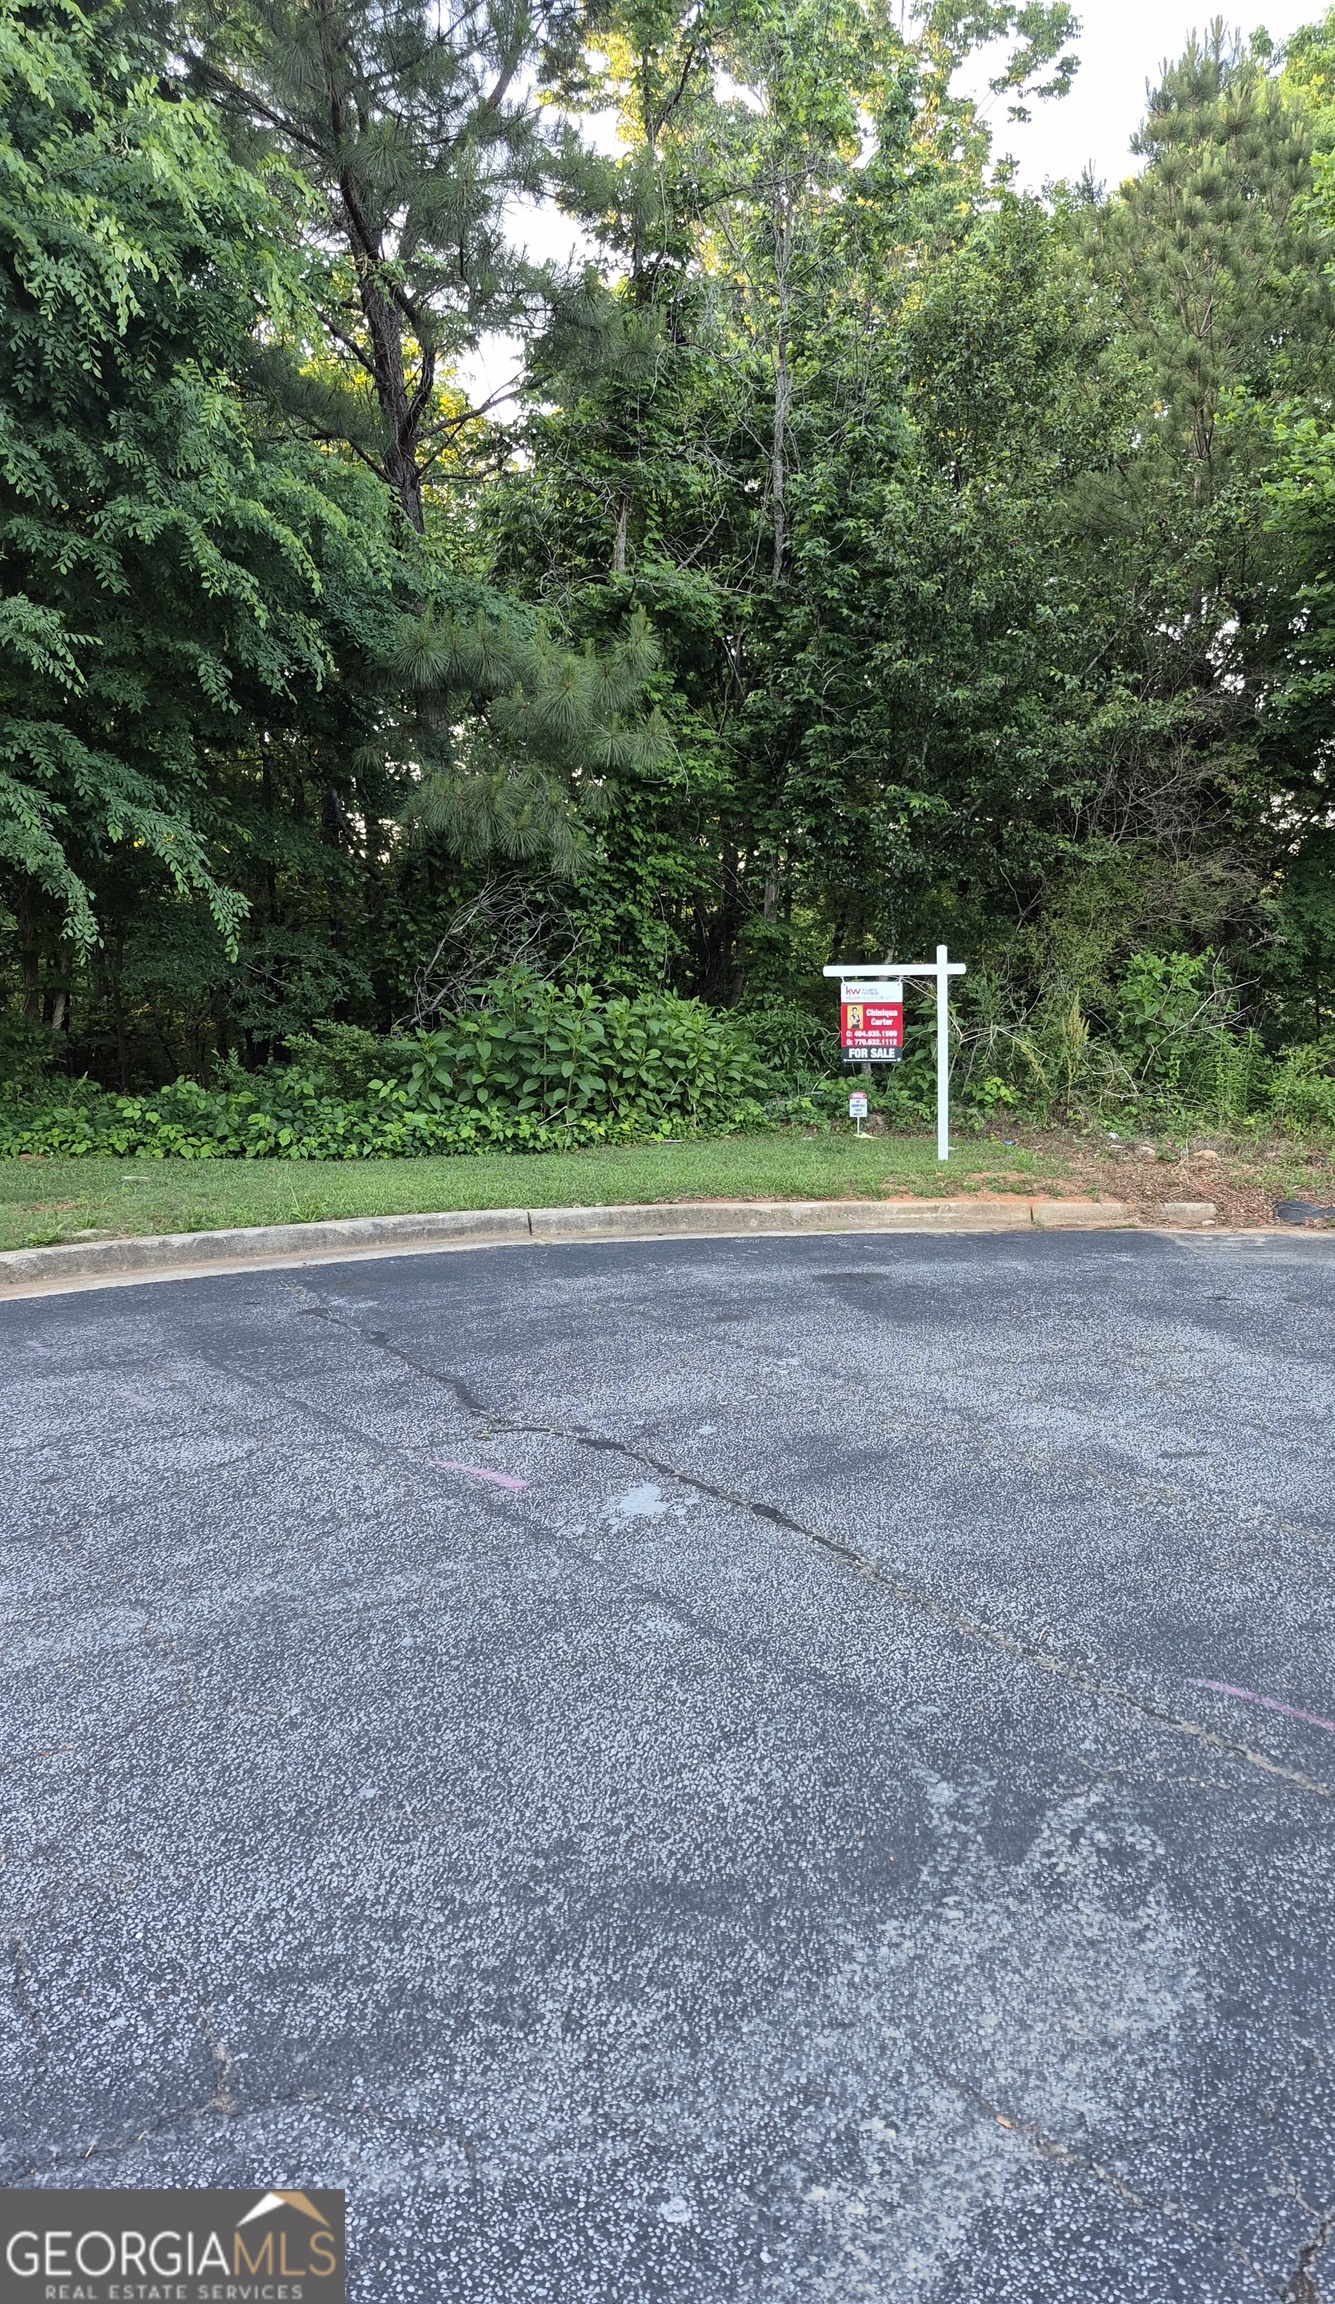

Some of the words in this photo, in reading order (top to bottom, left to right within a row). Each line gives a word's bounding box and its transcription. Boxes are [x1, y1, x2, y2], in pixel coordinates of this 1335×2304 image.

[846, 986, 861, 995] kw
[849, 1048, 868, 1058] FOR
[870, 1048, 895, 1058] SALE
